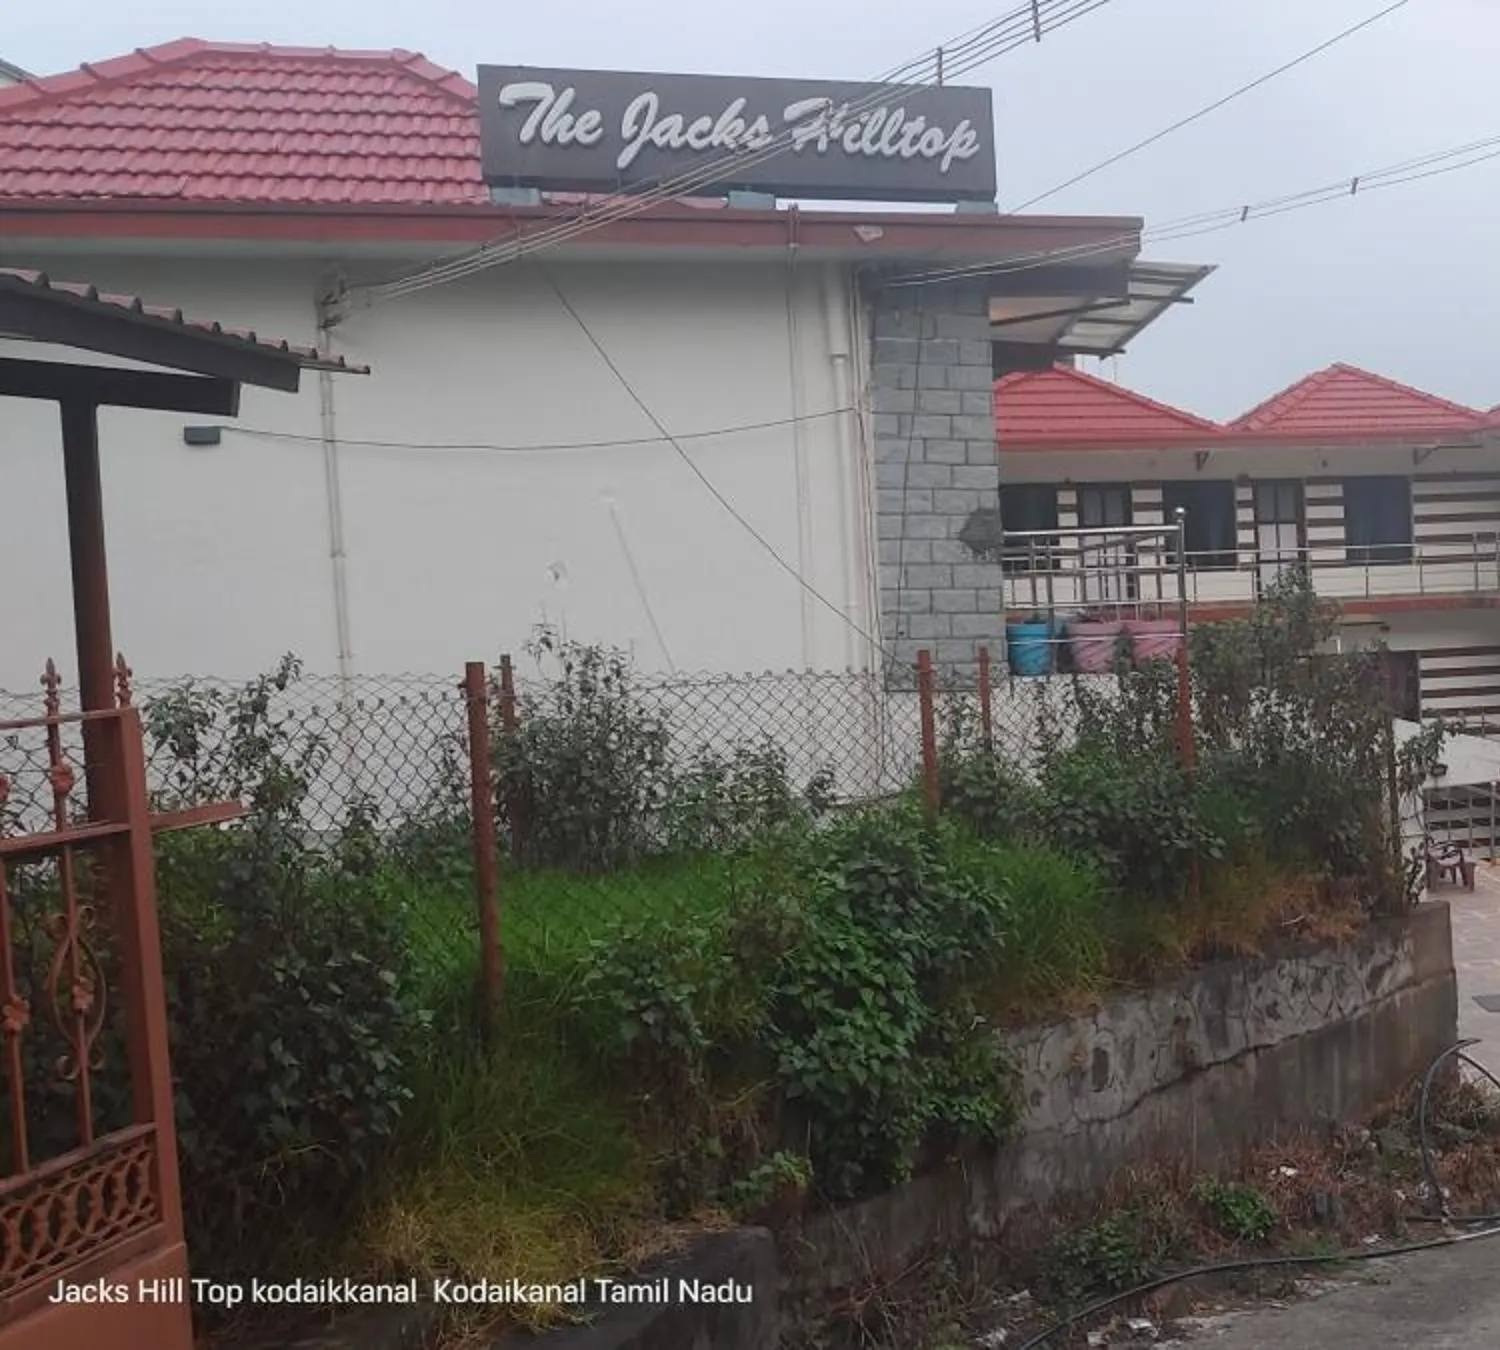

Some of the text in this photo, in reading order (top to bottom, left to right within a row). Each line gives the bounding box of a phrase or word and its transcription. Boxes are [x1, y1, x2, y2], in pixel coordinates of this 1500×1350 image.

[498, 82, 980, 173] The Jacks Hilltop
